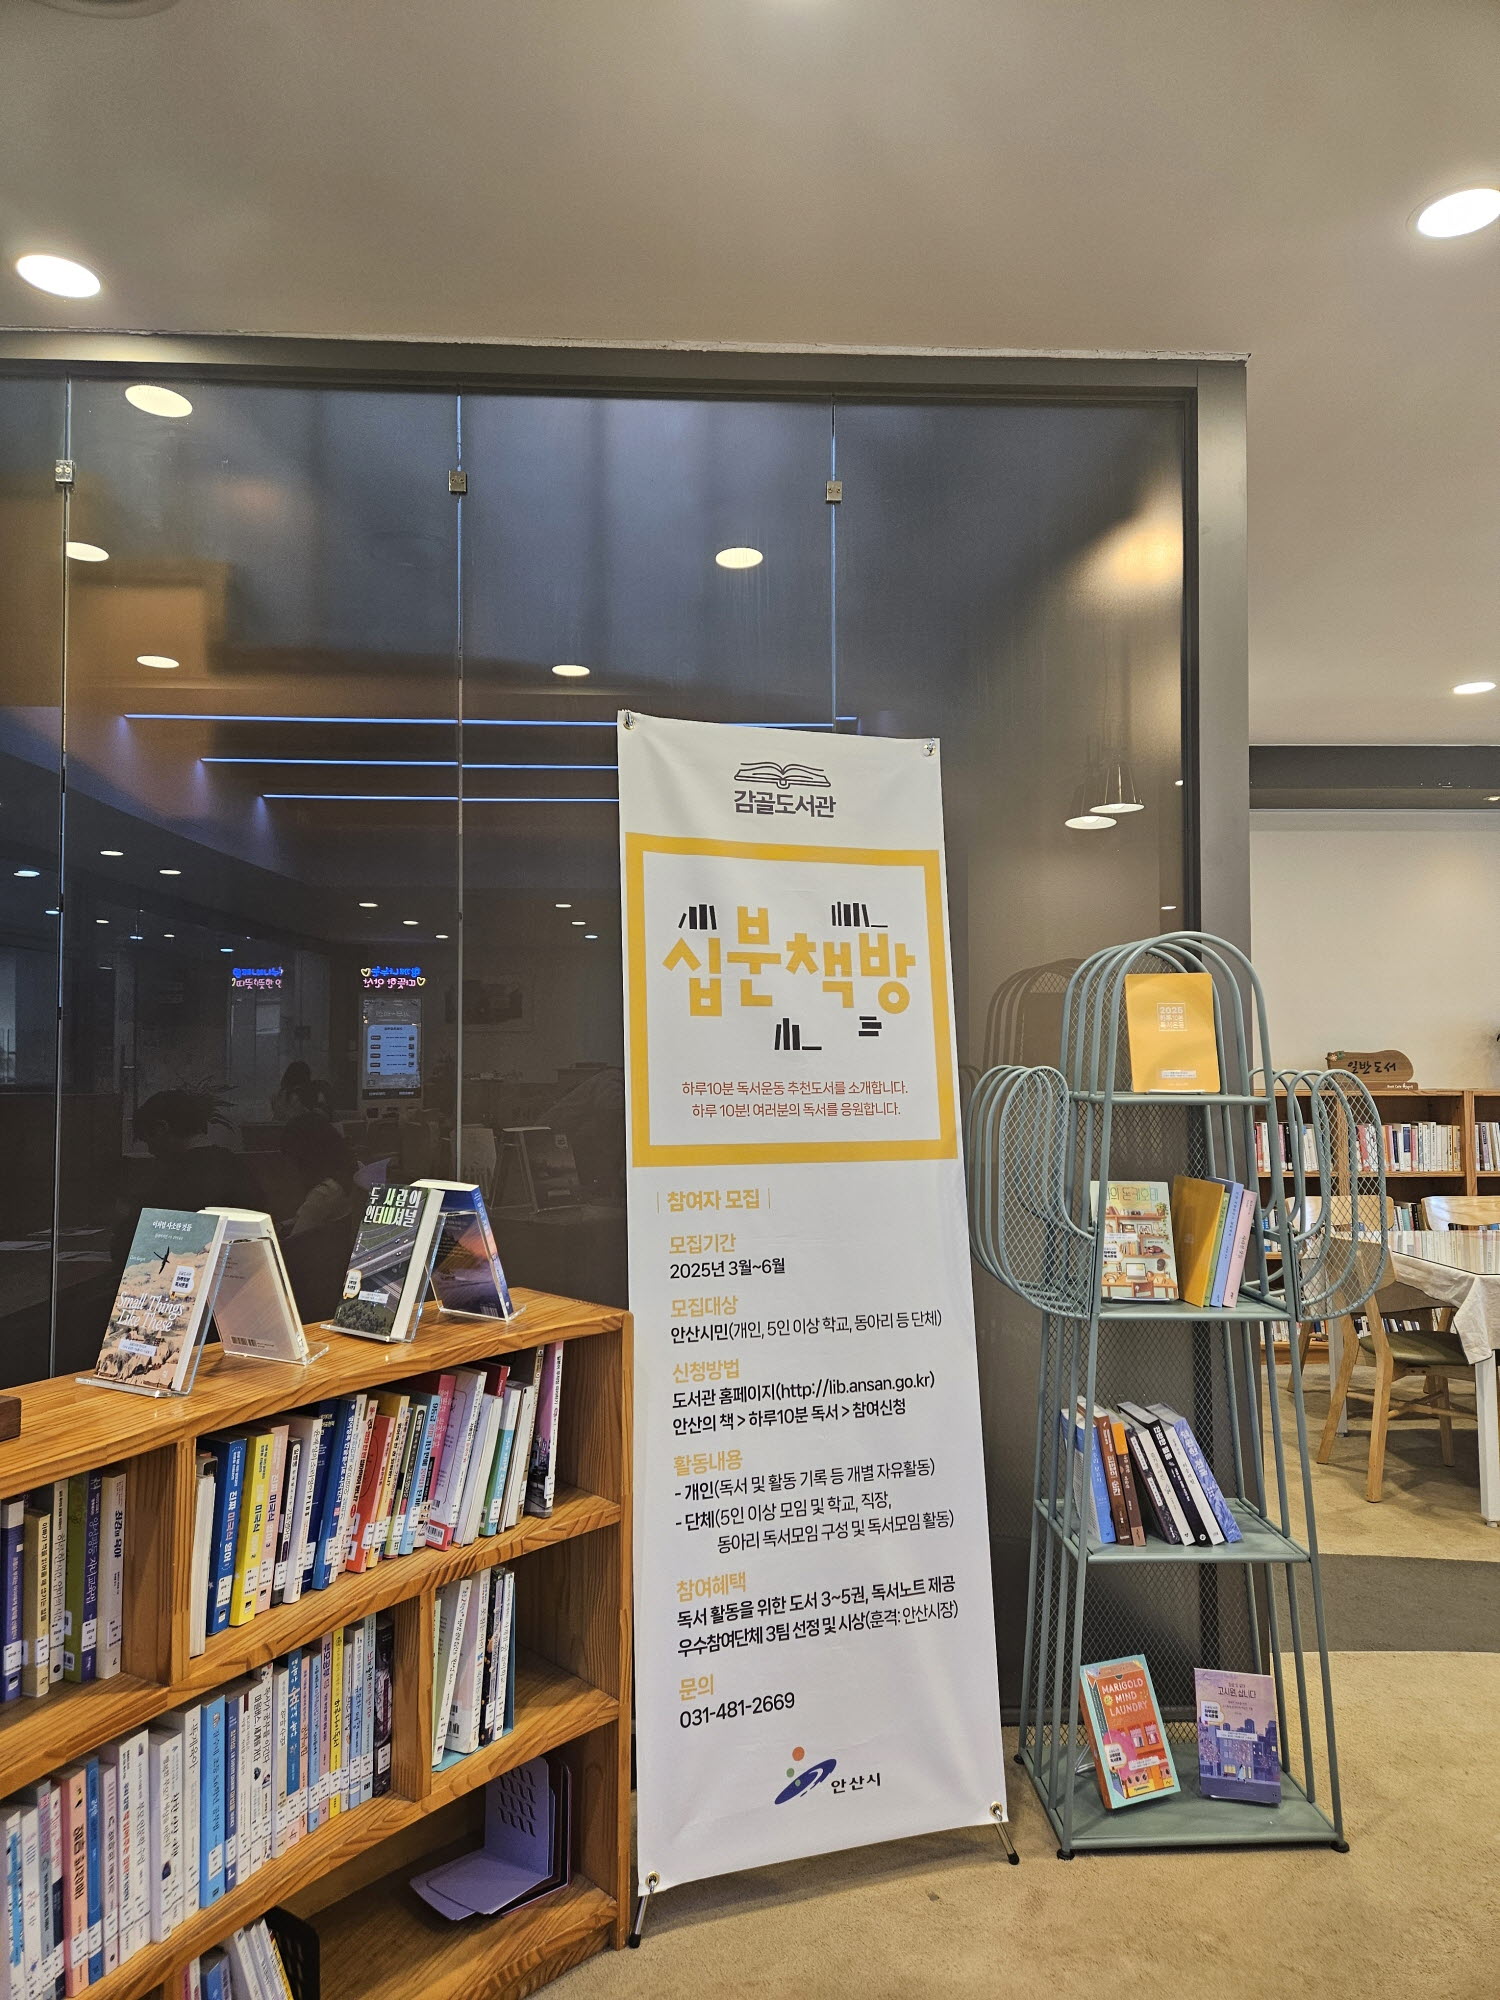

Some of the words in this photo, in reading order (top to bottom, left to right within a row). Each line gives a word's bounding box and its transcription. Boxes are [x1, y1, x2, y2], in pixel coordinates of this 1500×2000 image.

[733, 789, 836, 818] 감골도서관
[662, 905, 916, 1016] 십분책방
[1160, 1006, 1184, 1014] 2025
[682, 1080, 735, 1097] 하루10분
[736, 1080, 785, 1096] 독서운동
[787, 1080, 846, 1096] 추천도서를
[848, 1080, 909, 1096] 소개합니다.
[691, 1103, 718, 1118] 하루
[720, 1103, 751, 1119] 10분!
[752, 1102, 801, 1118] 여러분의
[802, 1102, 839, 1117] 독서를
[840, 1101, 902, 1117] 응원합니다.
[369, 1187, 381, 1204] 두
[384, 1188, 422, 1209] 사람의
[666, 1189, 721, 1213] 참여자
[725, 1188, 760, 1210] 모집
[363, 1207, 416, 1228] 인터내셔널
[669, 1233, 736, 1255] 모집기간
[669, 1261, 725, 1280] 2025년
[728, 1257, 786, 1277] 3월~6월
[117, 1291, 147, 1310] Small
[147, 1294, 184, 1320] Things
[670, 1295, 739, 1319] 모집대상
[116, 1308, 141, 1327] Like
[141, 1312, 174, 1332] These
[670, 1320, 765, 1344] 안산시민(개인,
[767, 1319, 791, 1337] 5인
[793, 1318, 821, 1335] 이상
[822, 1315, 852, 1334] 학교,
[854, 1312, 894, 1331] 동아리
[896, 1311, 910, 1329] 등
[911, 1309, 943, 1328] 단체)
[672, 1359, 740, 1384] 신청방법
[672, 1391, 716, 1410] 도서관
[672, 1414, 716, 1436] 안산의
[719, 1411, 734, 1431] 책
[748, 1406, 809, 1428] 하루10분
[811, 1401, 840, 1422] 독서
[852, 1397, 906, 1418] 참여신청
[673, 1449, 743, 1477] 활동내용
[684, 1476, 748, 1501] 개인(독서
[751, 1474, 765, 1492] 및
[768, 1470, 797, 1491] 활동
[800, 1467, 828, 1488] 기록
[830, 1467, 844, 1484] 등
[847, 1462, 874, 1483] 개별
[876, 1457, 935, 1480] 자유활동)
[228, 1490, 238, 1511] 진짜
[267, 1494, 277, 1522] 미국식
[684, 1507, 744, 1532] 단체(5인
[748, 1504, 776, 1523] 이상
[780, 1500, 807, 1519] 모임
[810, 1498, 825, 1516] 및
[827, 1494, 859, 1515] 학교,
[861, 1490, 892, 1510] 직장,
[225, 1511, 235, 1541] 미국식
[252, 1504, 263, 1533] 미국식
[717, 1534, 760, 1555] 동아리
[762, 1526, 818, 1548] 독서모임
[821, 1521, 849, 1541] 구성
[851, 1519, 865, 1537] 및
[867, 1513, 921, 1535] 독서모임
[922, 1509, 954, 1529] 활동)
[114, 1538, 123, 1559] 육아
[223, 1541, 233, 1562] 영어
[676, 1571, 747, 1603] 참여혜택
[677, 1606, 707, 1629] 독서
[710, 1601, 754, 1625] 활동을
[757, 1596, 787, 1618] 위한
[789, 1591, 818, 1612] 도서
[820, 1584, 869, 1608] 3~5권,
[871, 1578, 926, 1603] 독서노트
[928, 1574, 956, 1594] 제공
[677, 1627, 763, 1658] 우수참여단체
[765, 1622, 790, 1643] 3팀
[792, 1618, 820, 1640] 선정
[822, 1615, 837, 1635] 및
[838, 1607, 901, 1633] 시상(훈격:
[902, 1599, 959, 1625] 안산시장)
[679, 1674, 714, 1702] 문의
[1101, 1677, 1144, 1695] MARIGOLD
[1115, 1691, 1138, 1704] MIND
[679, 1692, 796, 1729] 031-481-2669
[1109, 1700, 1149, 1717] LAUNDRY
[830, 1772, 881, 1795] 안산시
